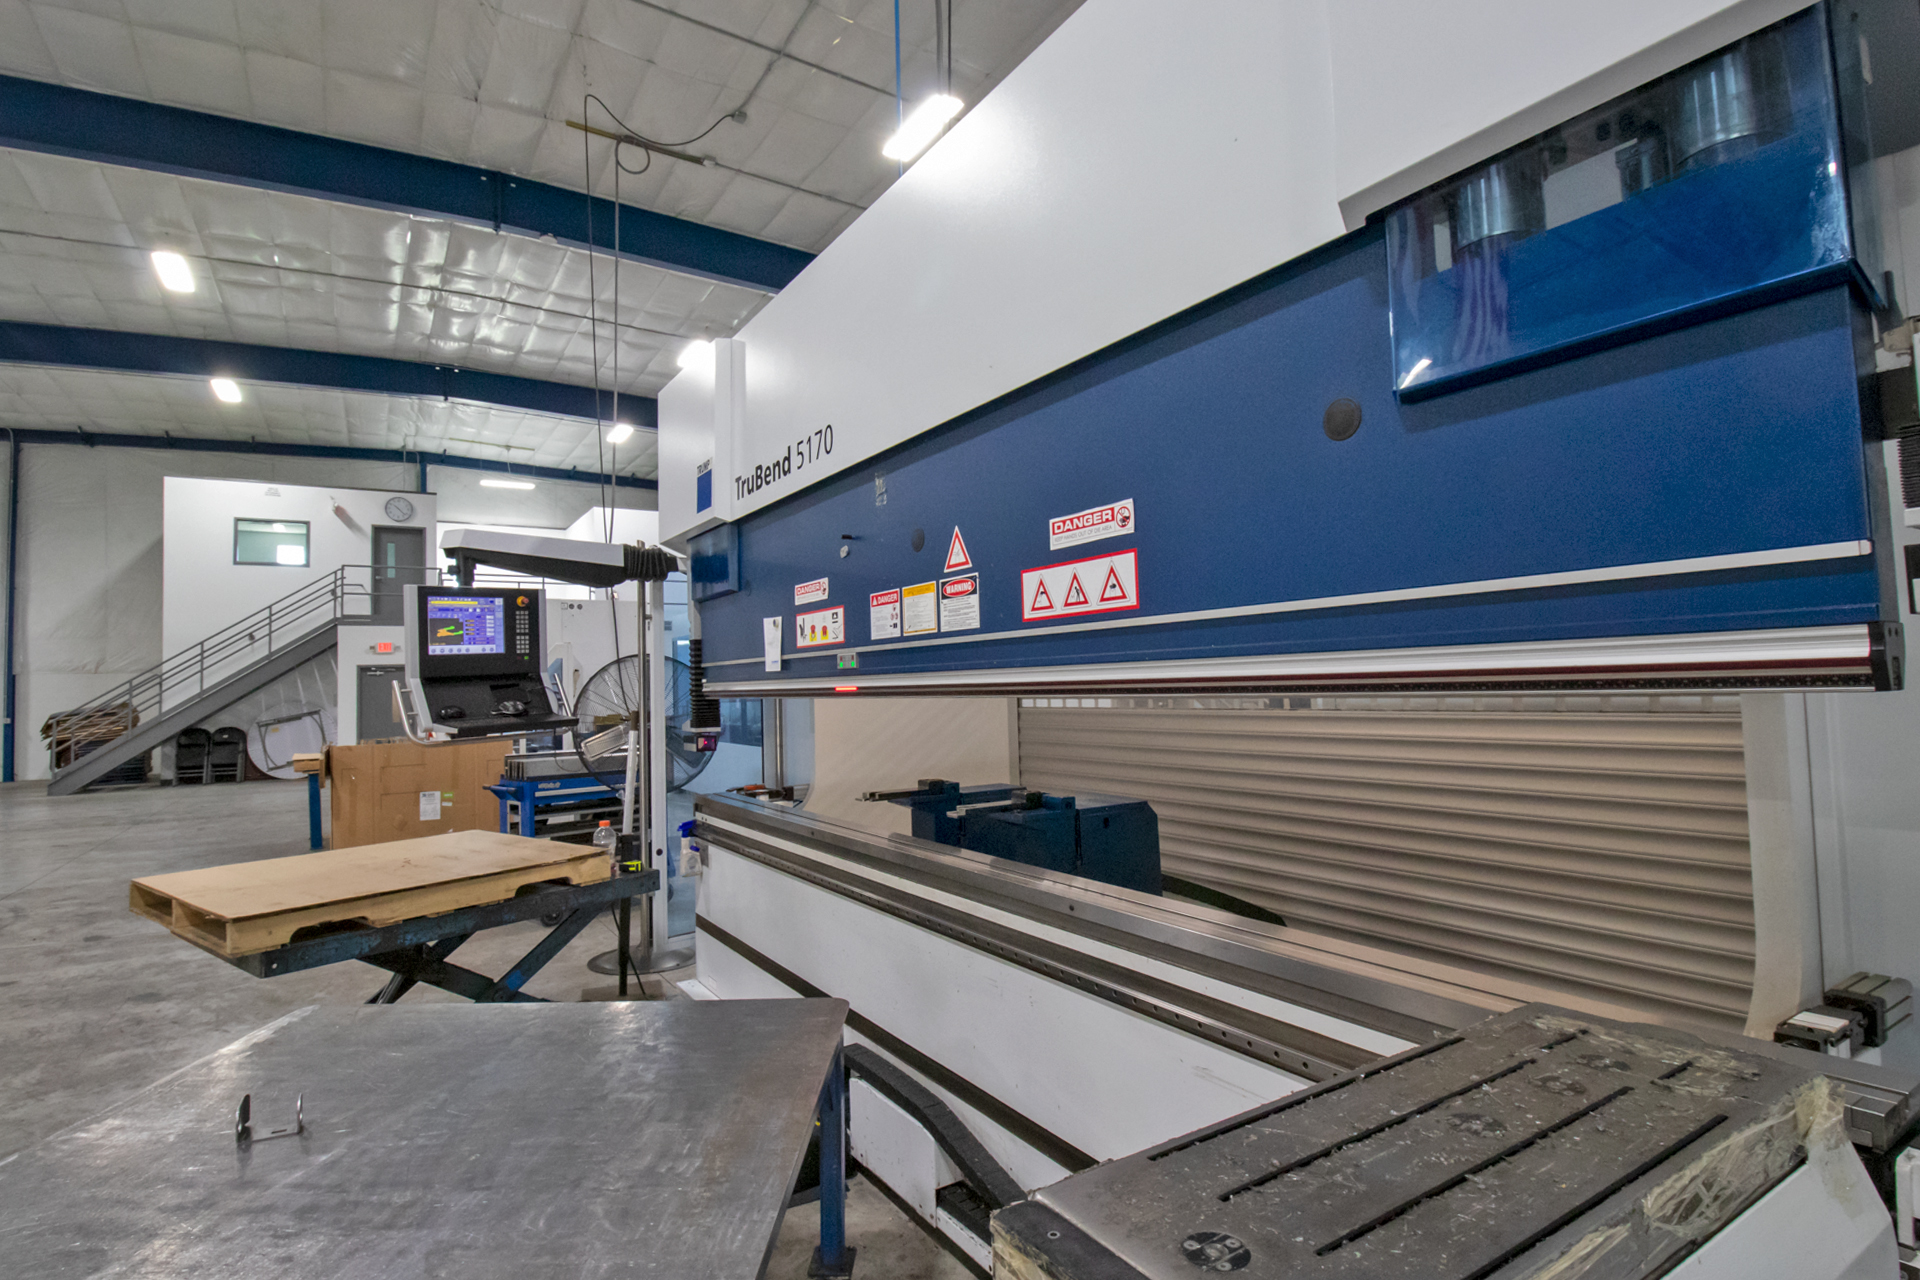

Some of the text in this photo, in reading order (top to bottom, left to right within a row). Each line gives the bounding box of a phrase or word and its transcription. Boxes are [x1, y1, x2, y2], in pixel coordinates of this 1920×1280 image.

[735, 424, 834, 500] TruBend 5170
[1054, 509, 1113, 534] DANGER
[946, 581, 972, 594] WARNING
[878, 593, 898, 605] DANGER
